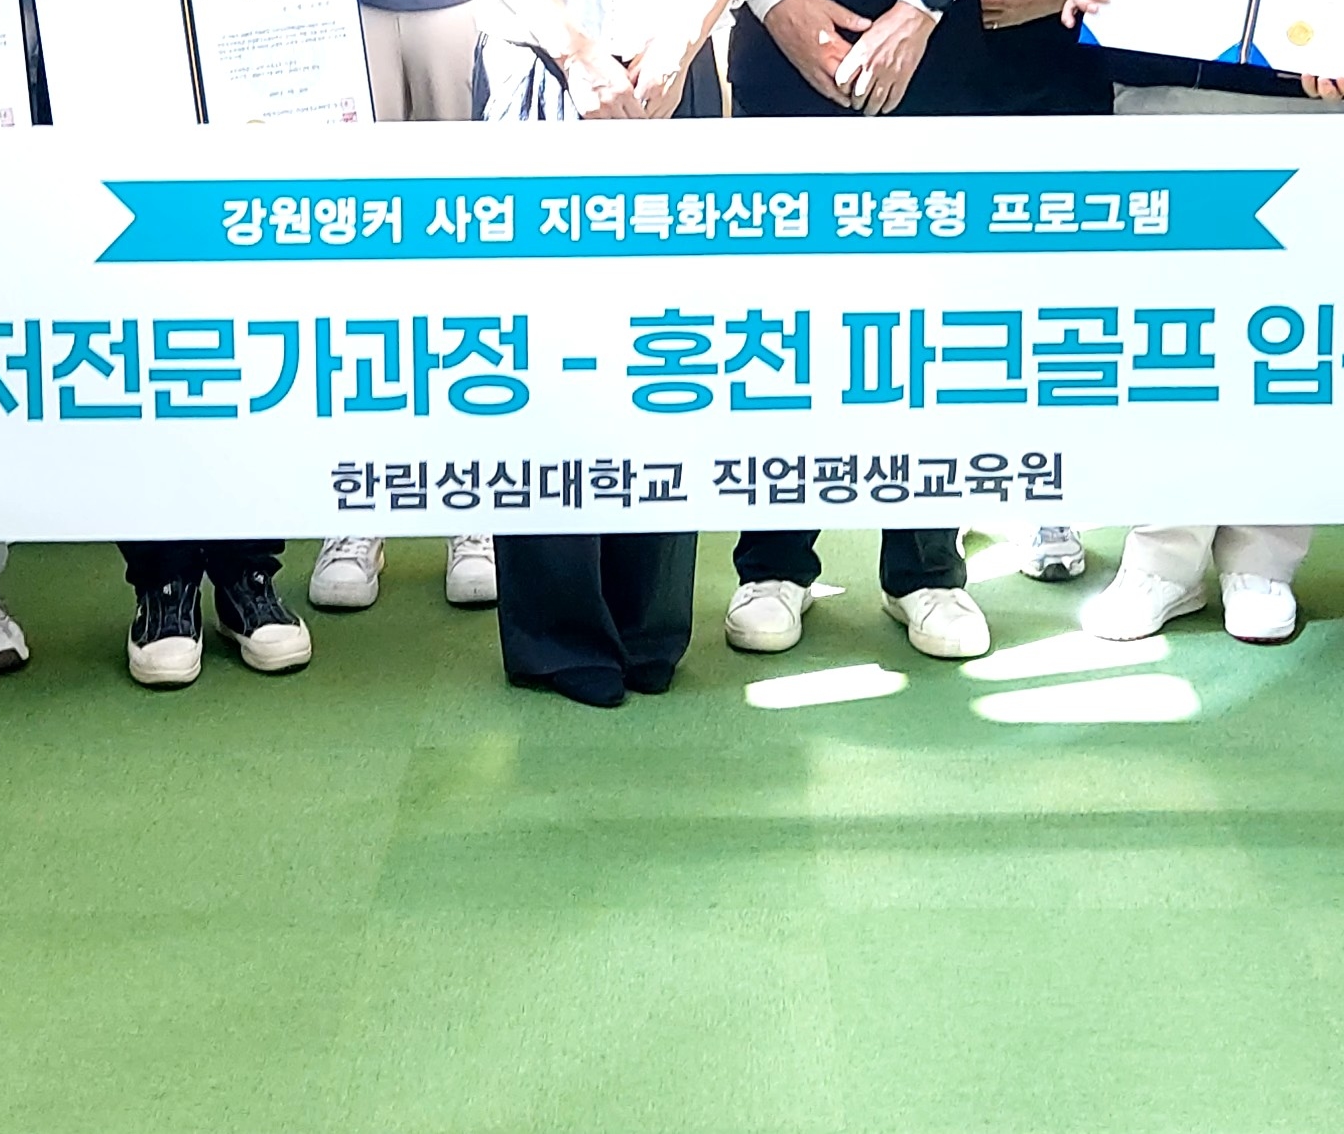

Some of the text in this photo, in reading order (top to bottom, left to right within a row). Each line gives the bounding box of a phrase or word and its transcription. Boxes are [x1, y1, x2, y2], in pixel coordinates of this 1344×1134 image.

[222, 188, 1171, 246] 강원앵커 사업 지역특화산업 맞춤형 프로그램
[626, 307, 813, 415] 홍천
[841, 306, 1220, 410] 파크골프
[331, 451, 1064, 511] 한림성심대학교 직업평생교육원
